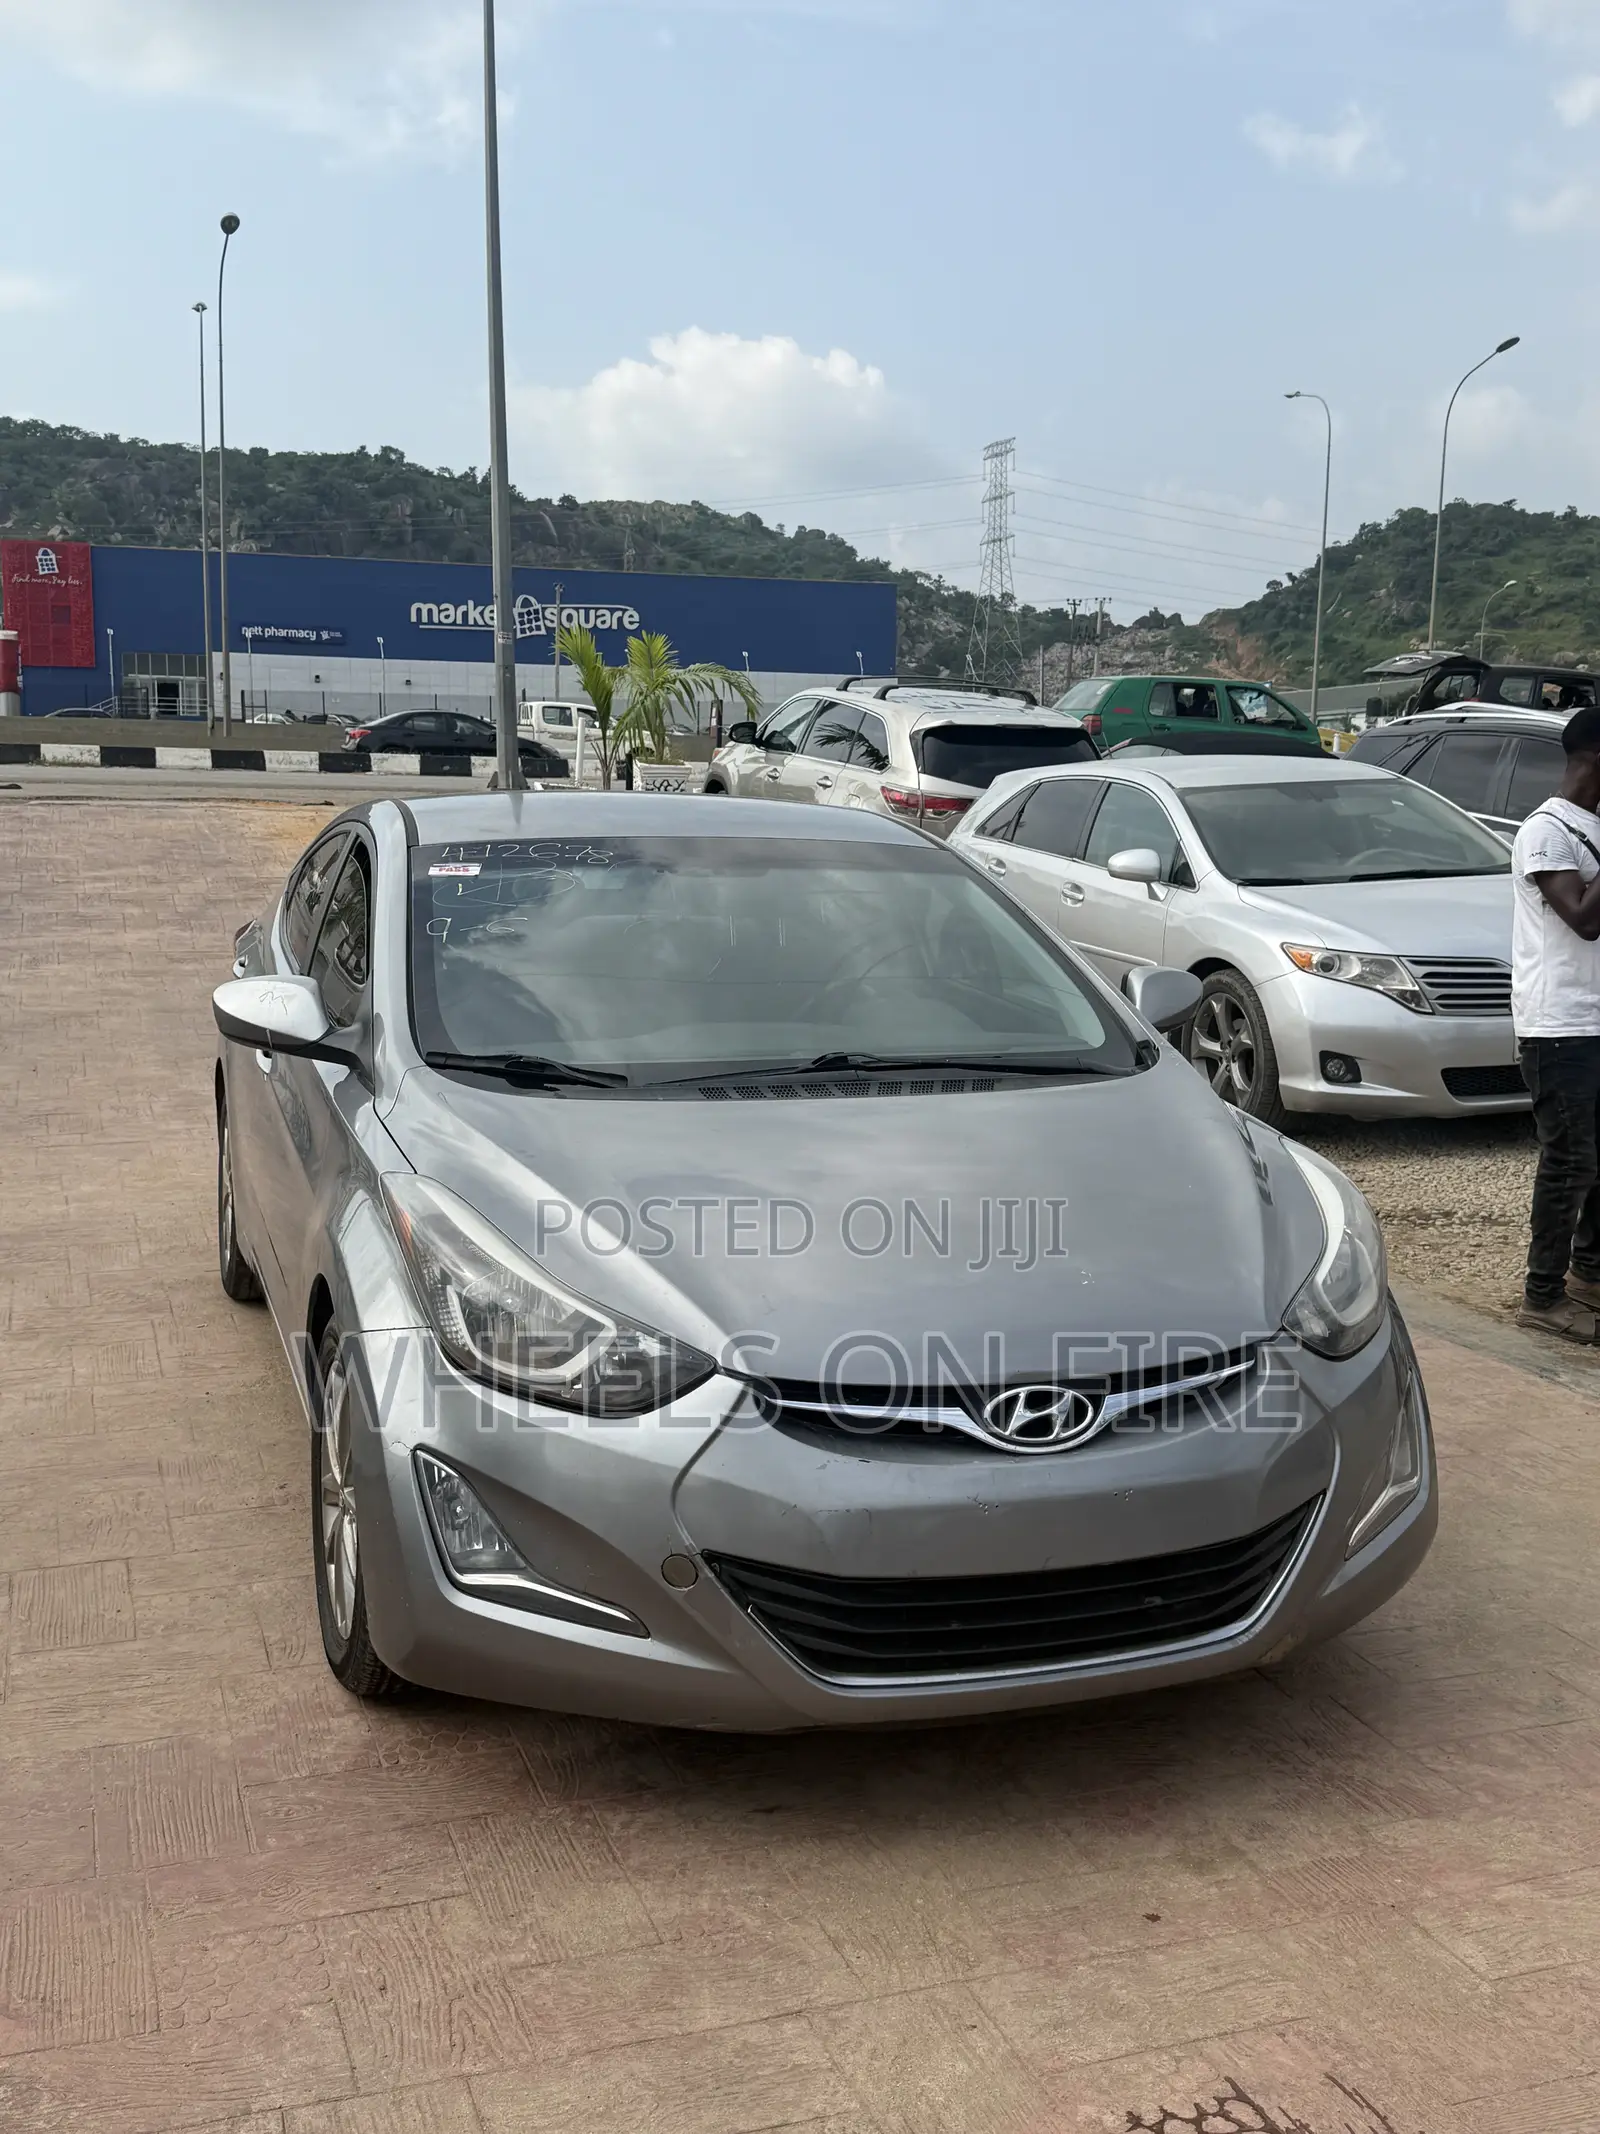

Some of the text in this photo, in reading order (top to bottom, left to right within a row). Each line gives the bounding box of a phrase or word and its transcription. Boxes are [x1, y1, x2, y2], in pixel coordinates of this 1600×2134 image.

[410, 600, 640, 630] marke square
[264, 626, 317, 641] pharmacy
